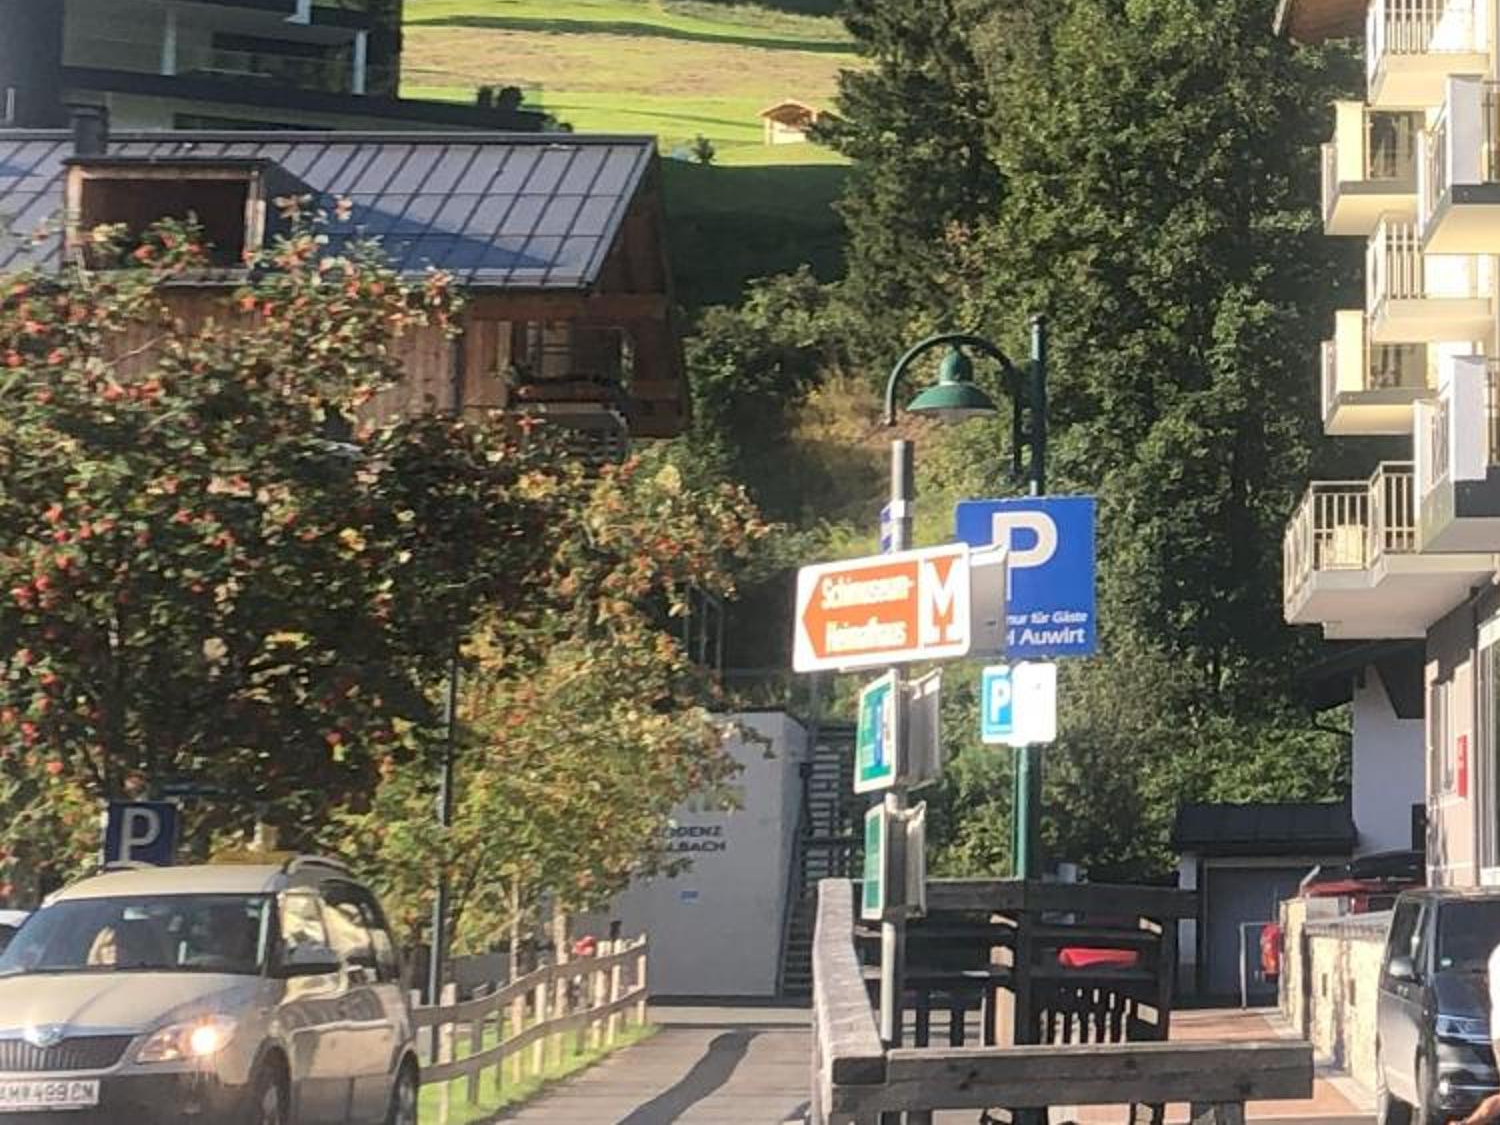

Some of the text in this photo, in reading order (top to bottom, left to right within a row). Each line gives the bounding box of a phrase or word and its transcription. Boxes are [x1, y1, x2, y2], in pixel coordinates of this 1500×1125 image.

[992, 510, 1058, 602] P
[1019, 626, 1086, 646] Auwirt
[1030, 611, 1050, 624] für
[121, 807, 160, 863] P
